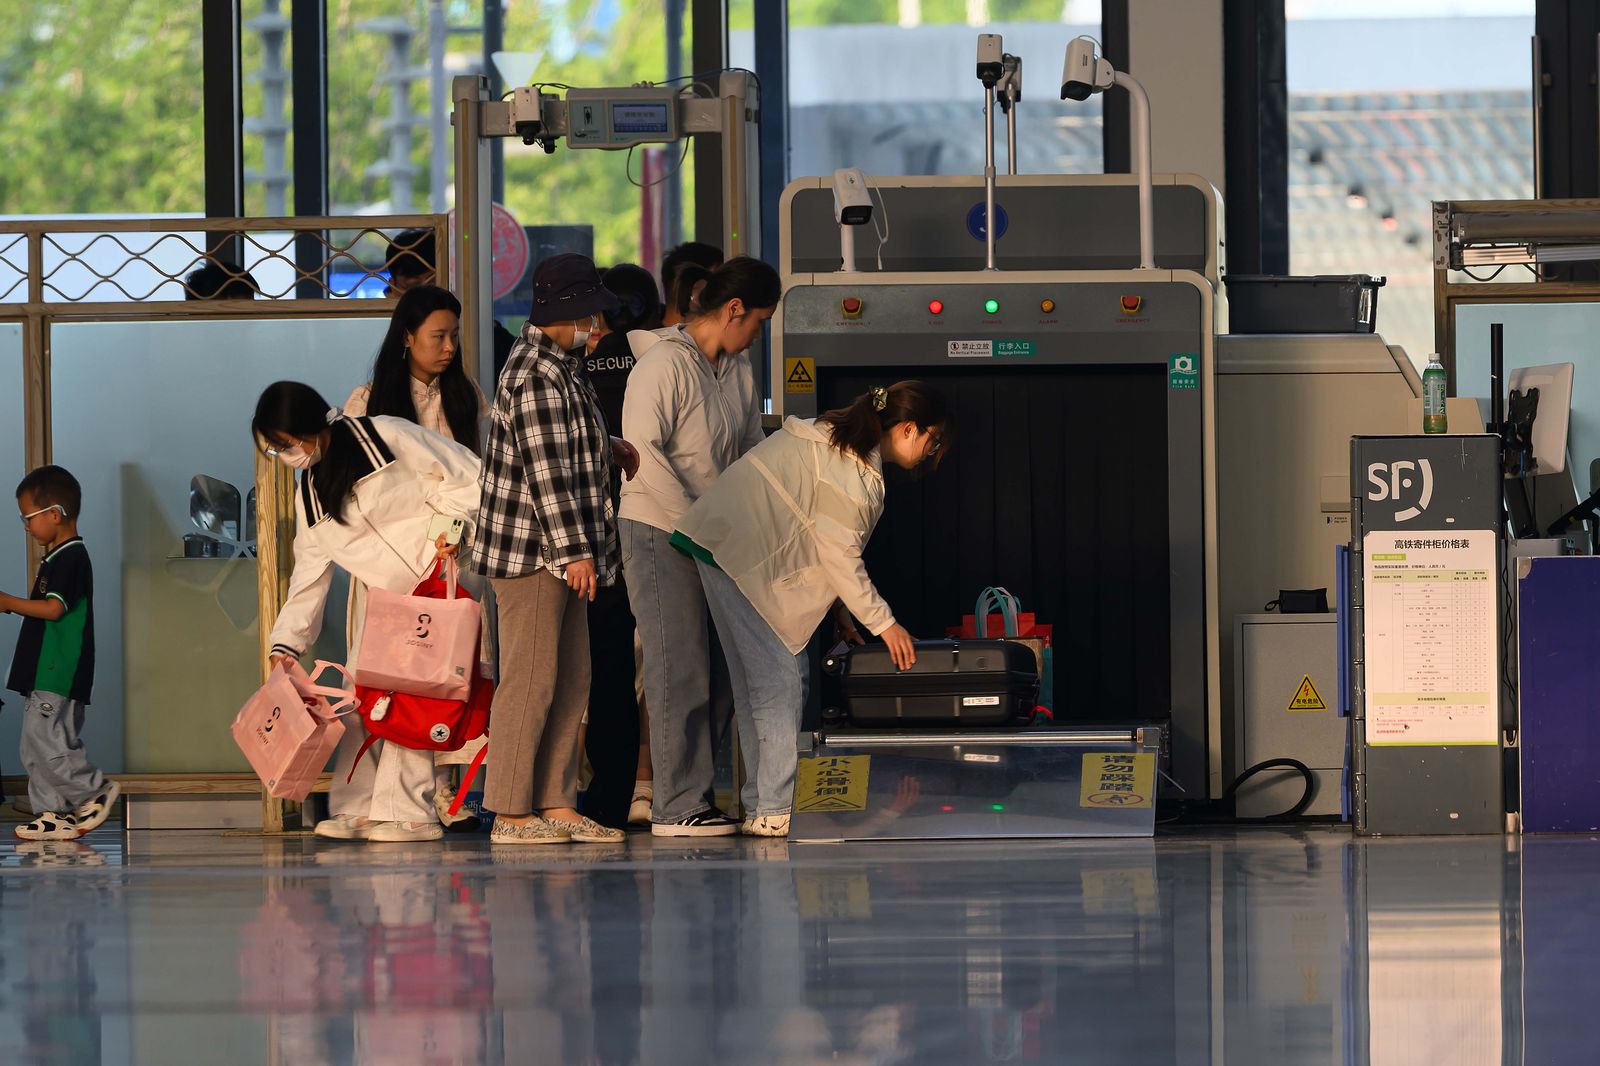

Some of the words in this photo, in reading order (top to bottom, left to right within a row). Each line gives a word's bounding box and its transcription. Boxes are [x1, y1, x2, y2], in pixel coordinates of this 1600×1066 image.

[998, 342, 1029, 350] 行李入口
[587, 356, 634, 371] SECUR
[1394, 539, 1470, 549] 高铁寄件柜价格表
[814, 758, 852, 797] 小心滑倒
[1099, 755, 1137, 792] 请勿踩踏
